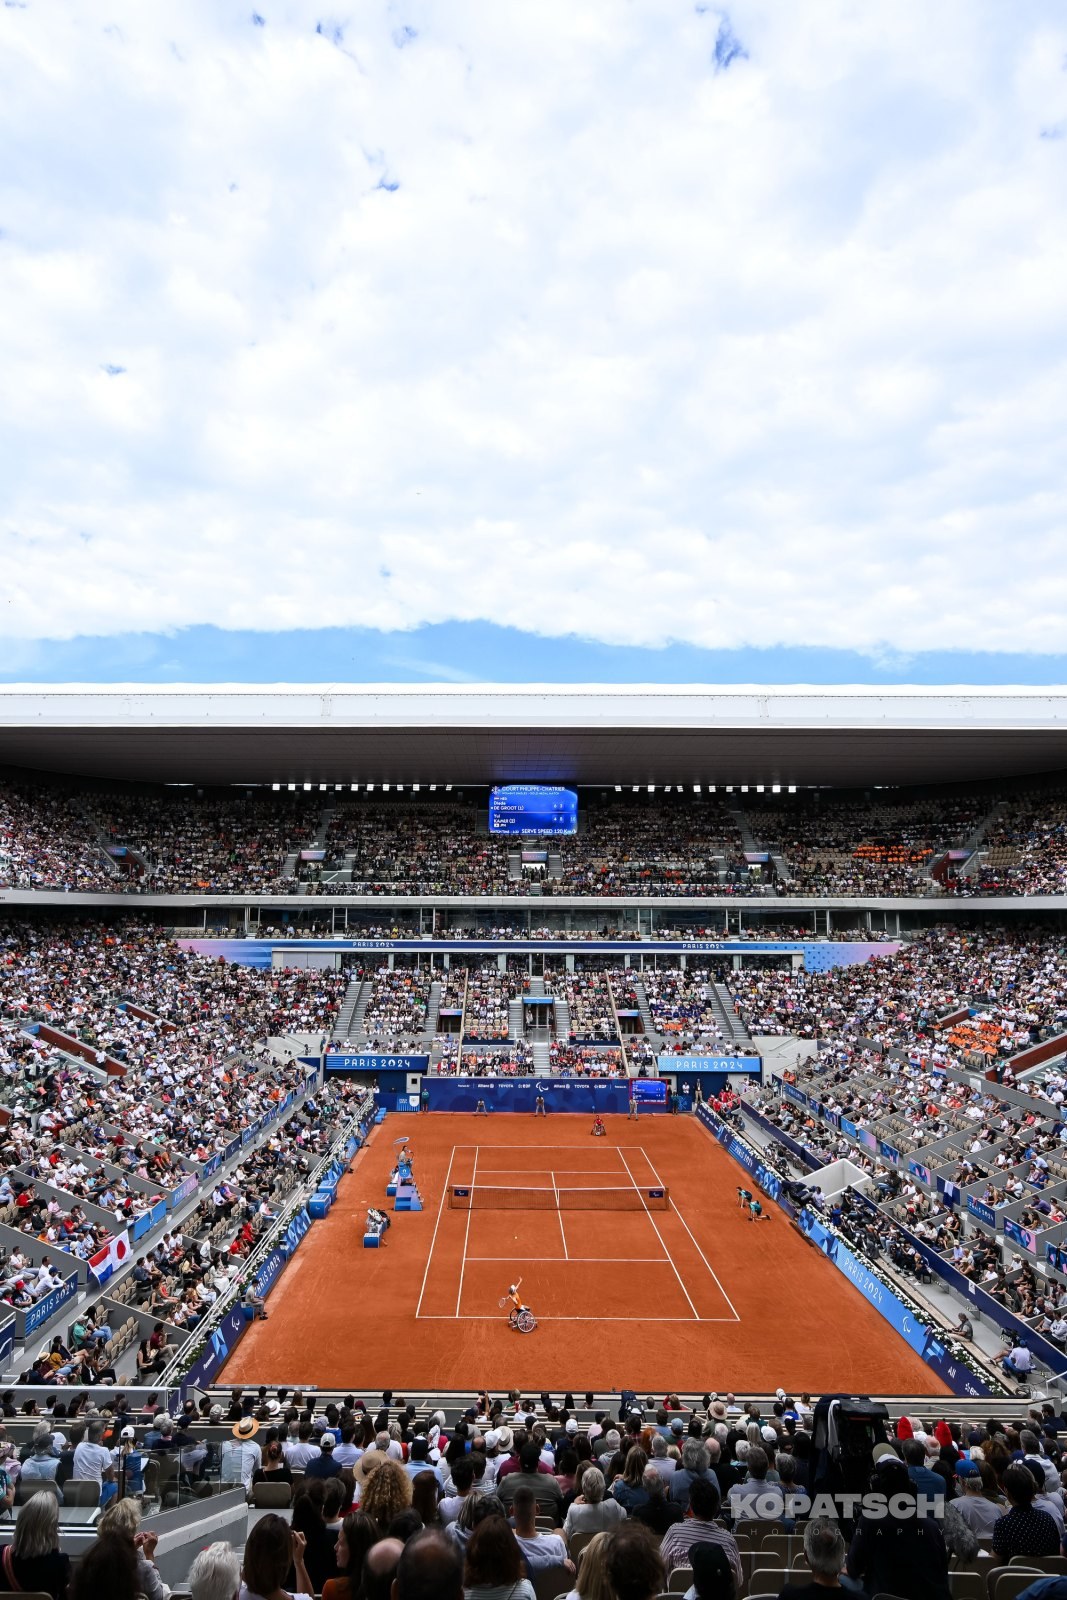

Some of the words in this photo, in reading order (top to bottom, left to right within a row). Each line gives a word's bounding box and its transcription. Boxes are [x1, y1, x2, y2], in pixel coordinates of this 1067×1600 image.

[344, 1058, 377, 1067] PARIS
[380, 1058, 410, 1068] 2024
[676, 1061, 709, 1069] PARIS
[713, 1061, 743, 1069] 2024
[267, 1254, 281, 1277] 2024
[843, 1258, 864, 1283] PARIS
[863, 1277, 883, 1304] 2024
[30, 1298, 54, 1325] PARIS
[55, 1281, 75, 1304] 2024
